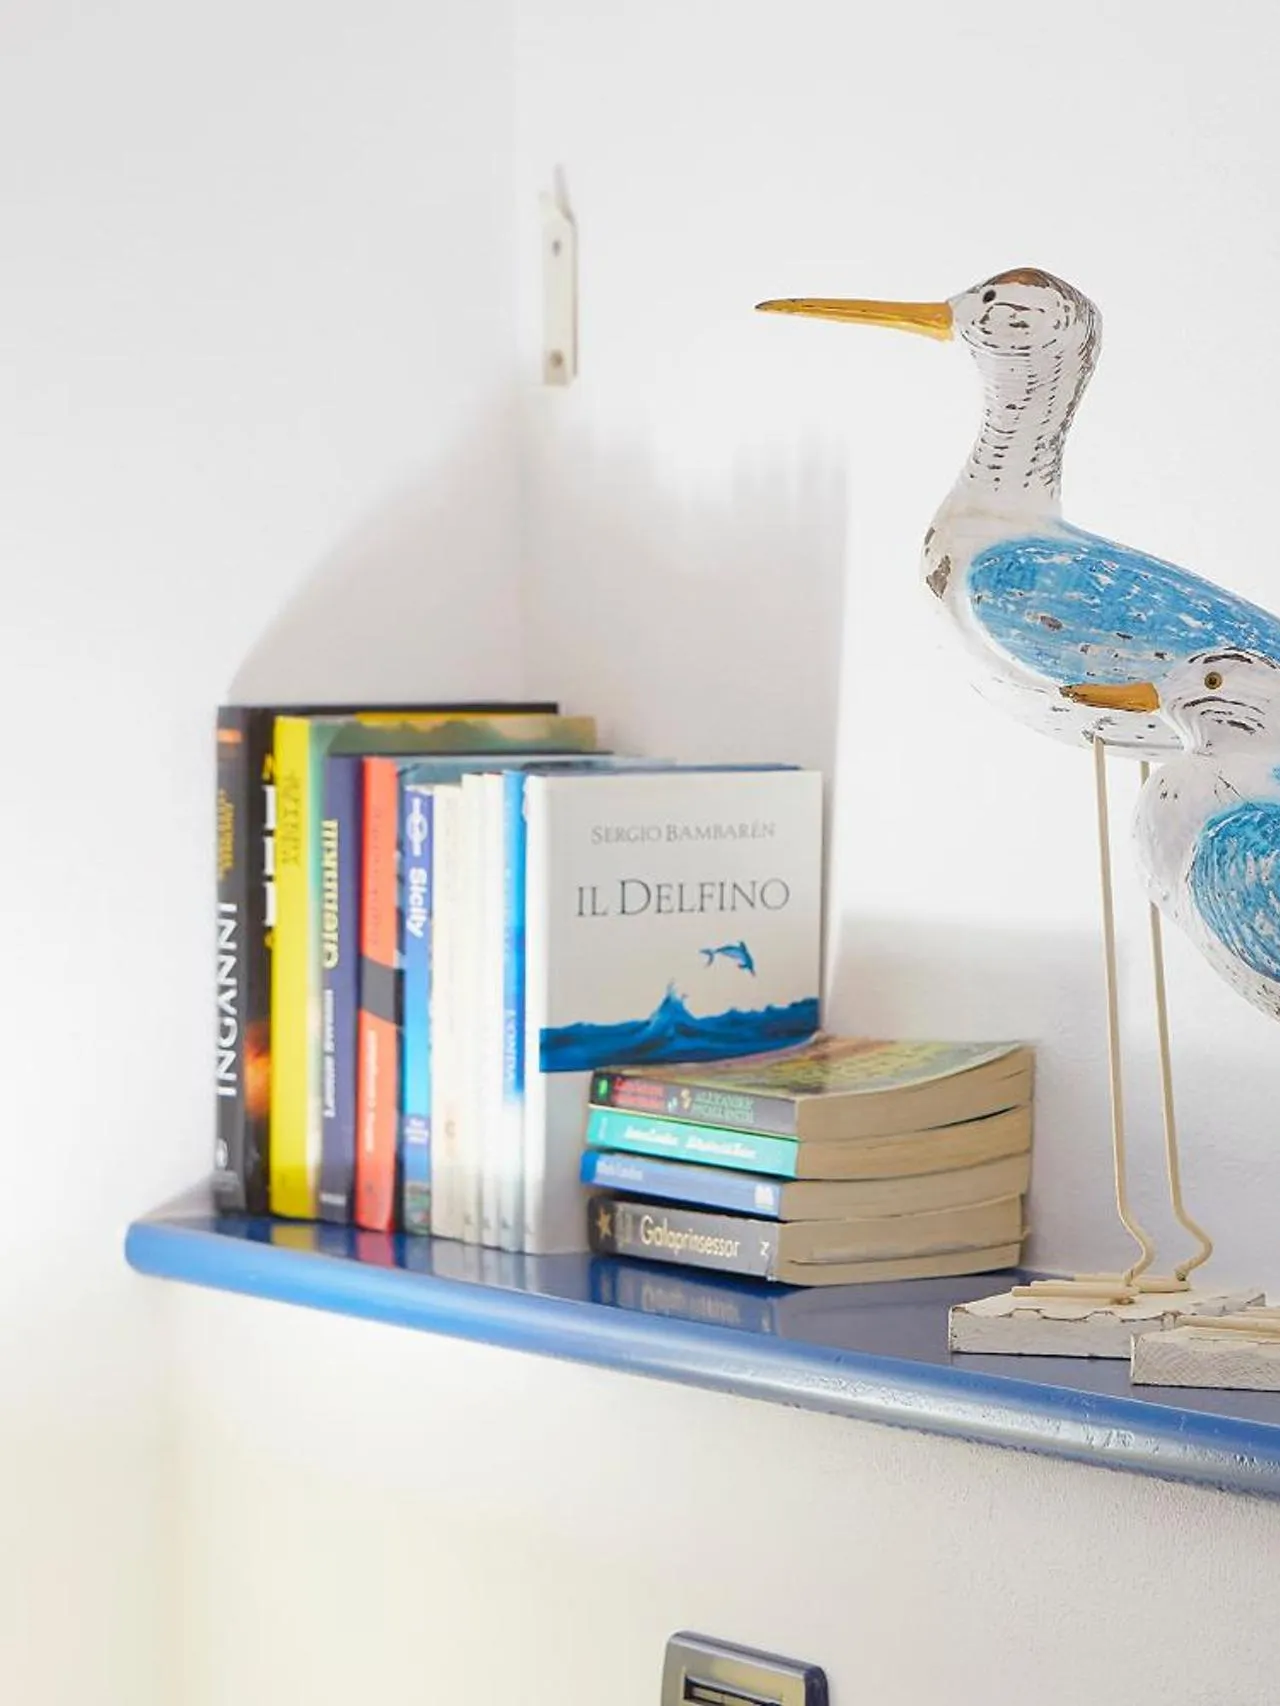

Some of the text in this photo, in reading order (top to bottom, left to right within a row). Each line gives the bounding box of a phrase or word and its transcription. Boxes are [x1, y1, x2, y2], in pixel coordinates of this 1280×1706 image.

[591, 825, 662, 845] SERGIO
[406, 867, 428, 938] Sicily
[576, 878, 791, 918] IL DELFINO
[216, 903, 238, 1097] INGANNI
